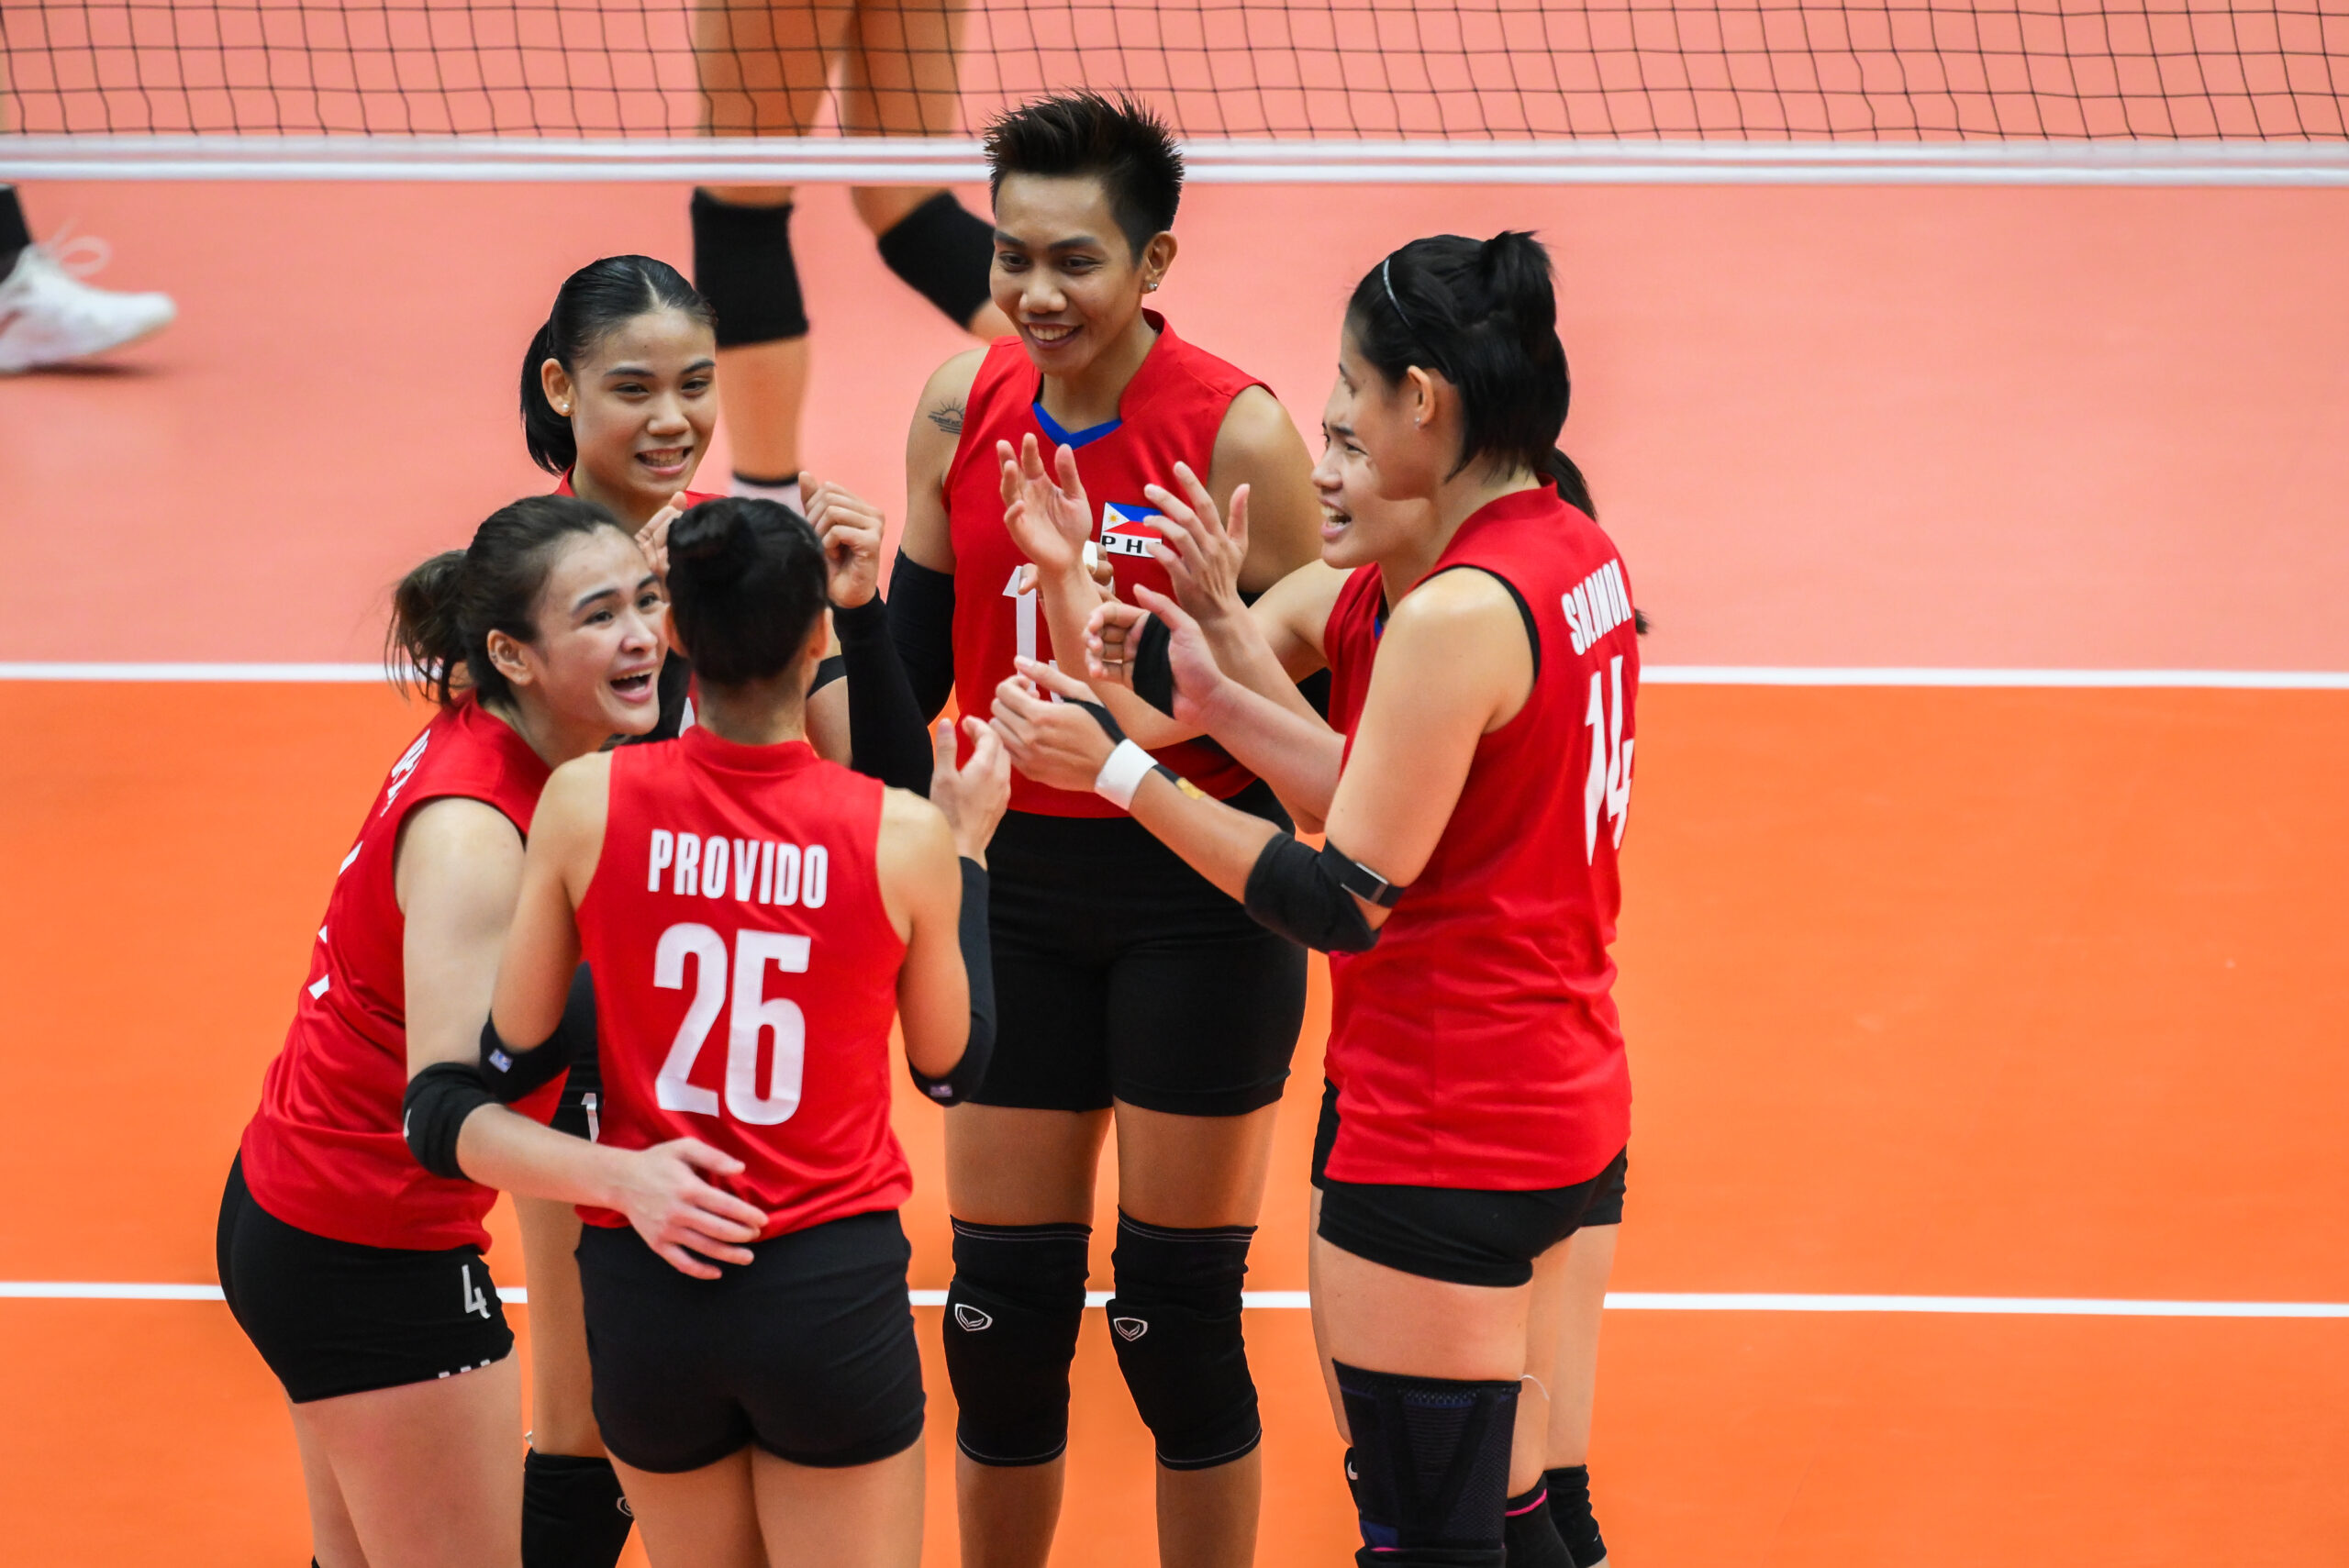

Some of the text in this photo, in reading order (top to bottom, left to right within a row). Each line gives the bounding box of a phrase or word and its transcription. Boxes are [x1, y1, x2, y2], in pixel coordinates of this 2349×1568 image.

[1101, 535, 1161, 554] PH
[1584, 655, 1635, 866] 14
[647, 828, 829, 908] PROVIDO
[653, 922, 811, 1126] 26
[461, 1263, 492, 1319] 4
